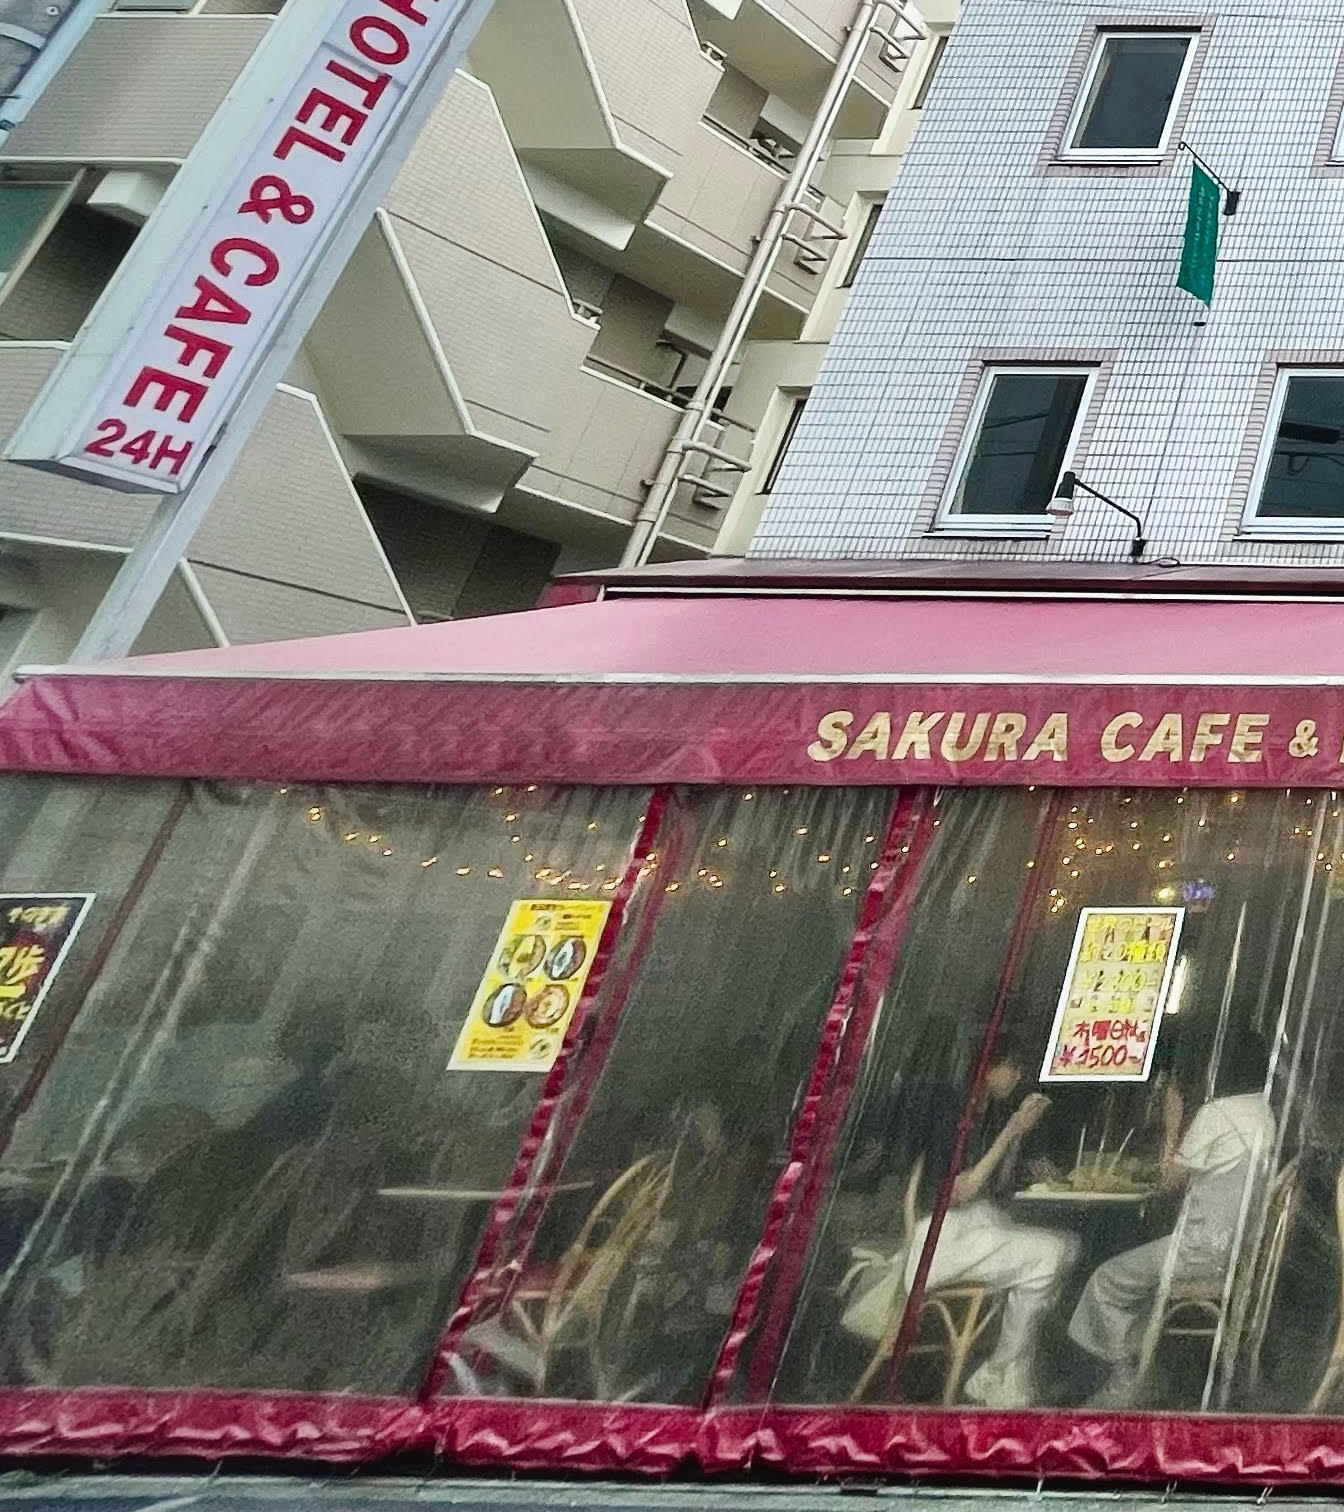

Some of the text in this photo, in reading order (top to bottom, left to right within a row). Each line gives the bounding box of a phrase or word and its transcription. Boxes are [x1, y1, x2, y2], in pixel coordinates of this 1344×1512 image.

[237, 175, 315, 225] &
[122, 237, 281, 424] CAFE
[84, 418, 195, 476] 24H
[807, 710, 1068, 763] SAKURA
[1100, 711, 1270, 763] CAFE
[1288, 719, 1320, 758] &
